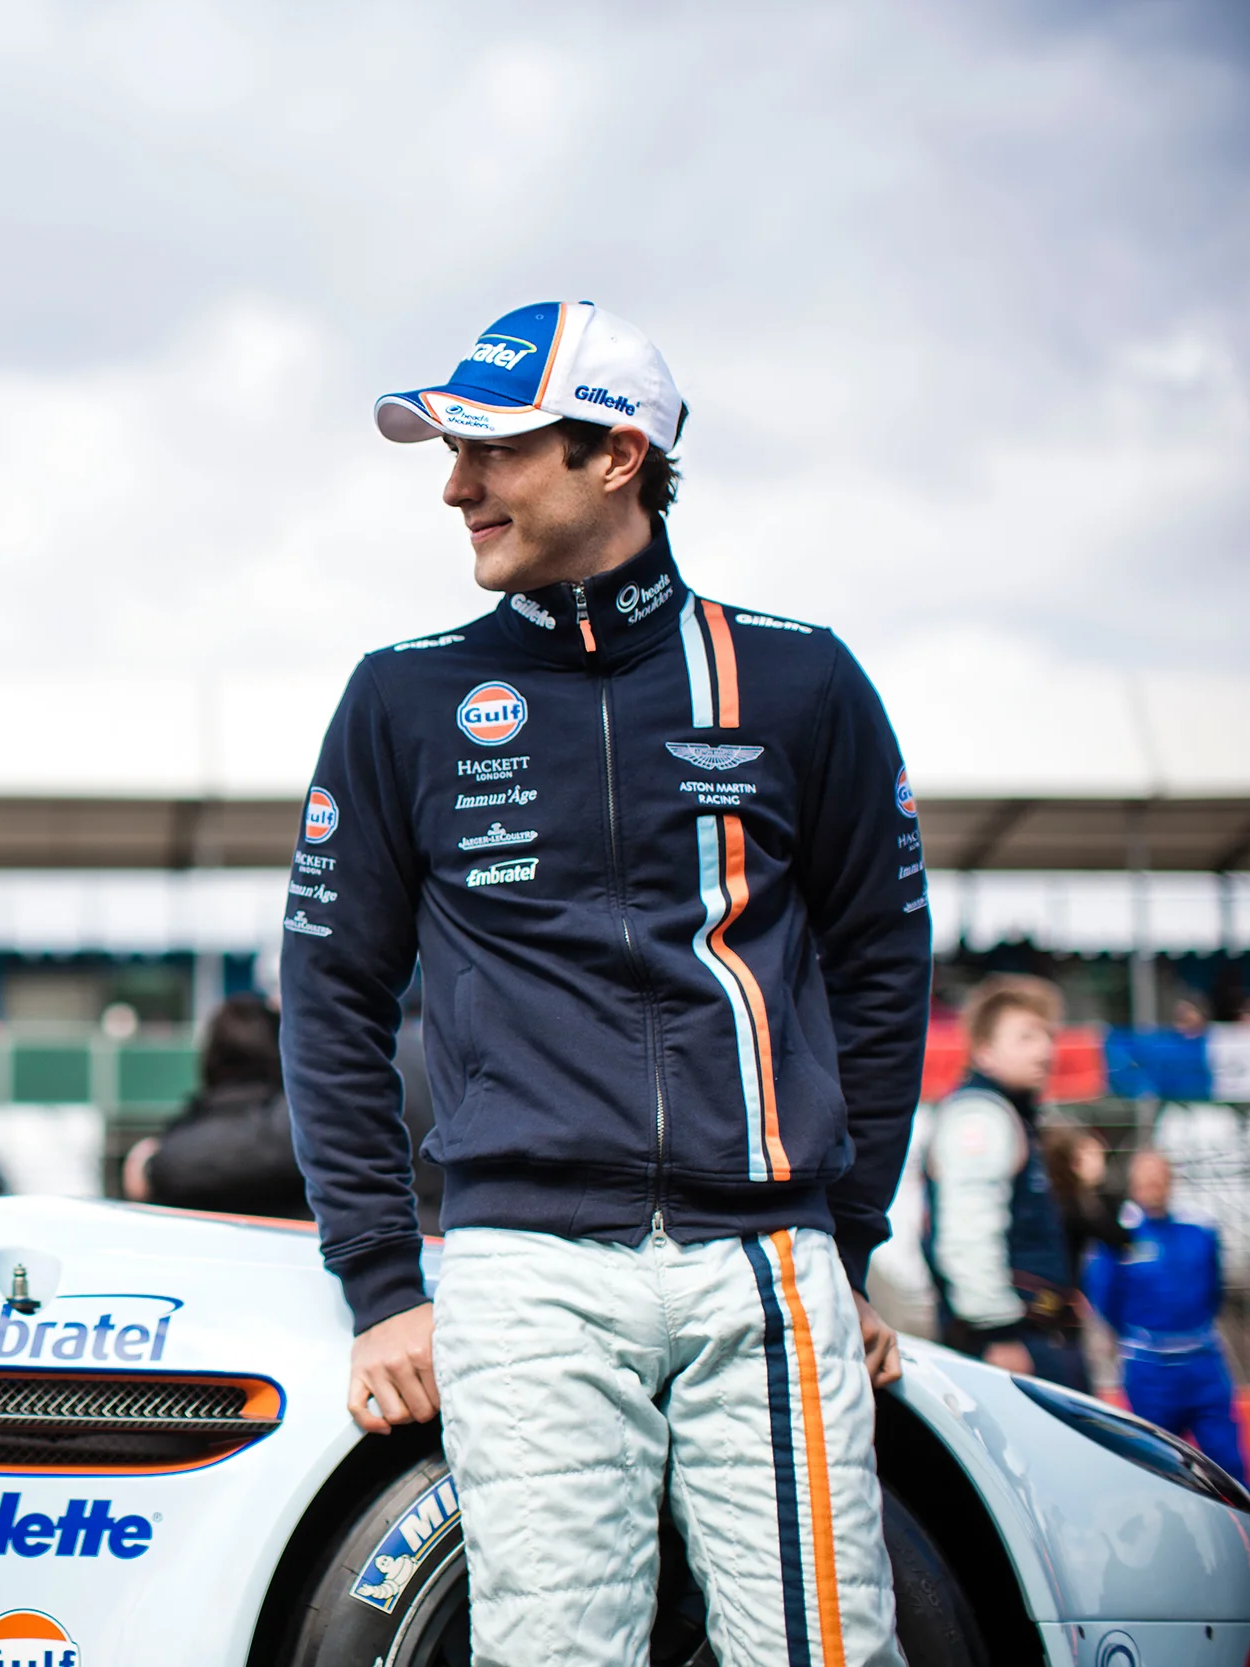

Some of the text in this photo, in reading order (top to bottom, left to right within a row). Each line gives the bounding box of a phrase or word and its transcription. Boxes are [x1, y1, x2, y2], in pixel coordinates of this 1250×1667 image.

[574, 384, 636, 417] Gillette
[447, 416, 489, 429] shoulders
[510, 593, 557, 630] Gillette
[628, 585, 674, 625] shoulders
[735, 613, 813, 634] Gillette
[464, 704, 521, 724] Gulf
[457, 756, 530, 776] HACKETT
[476, 771, 513, 782] LONDON
[679, 781, 757, 794] ASTON MARTIN
[697, 794, 741, 806] RACING
[306, 810, 334, 826] ulf
[465, 862, 537, 888] Embratel
